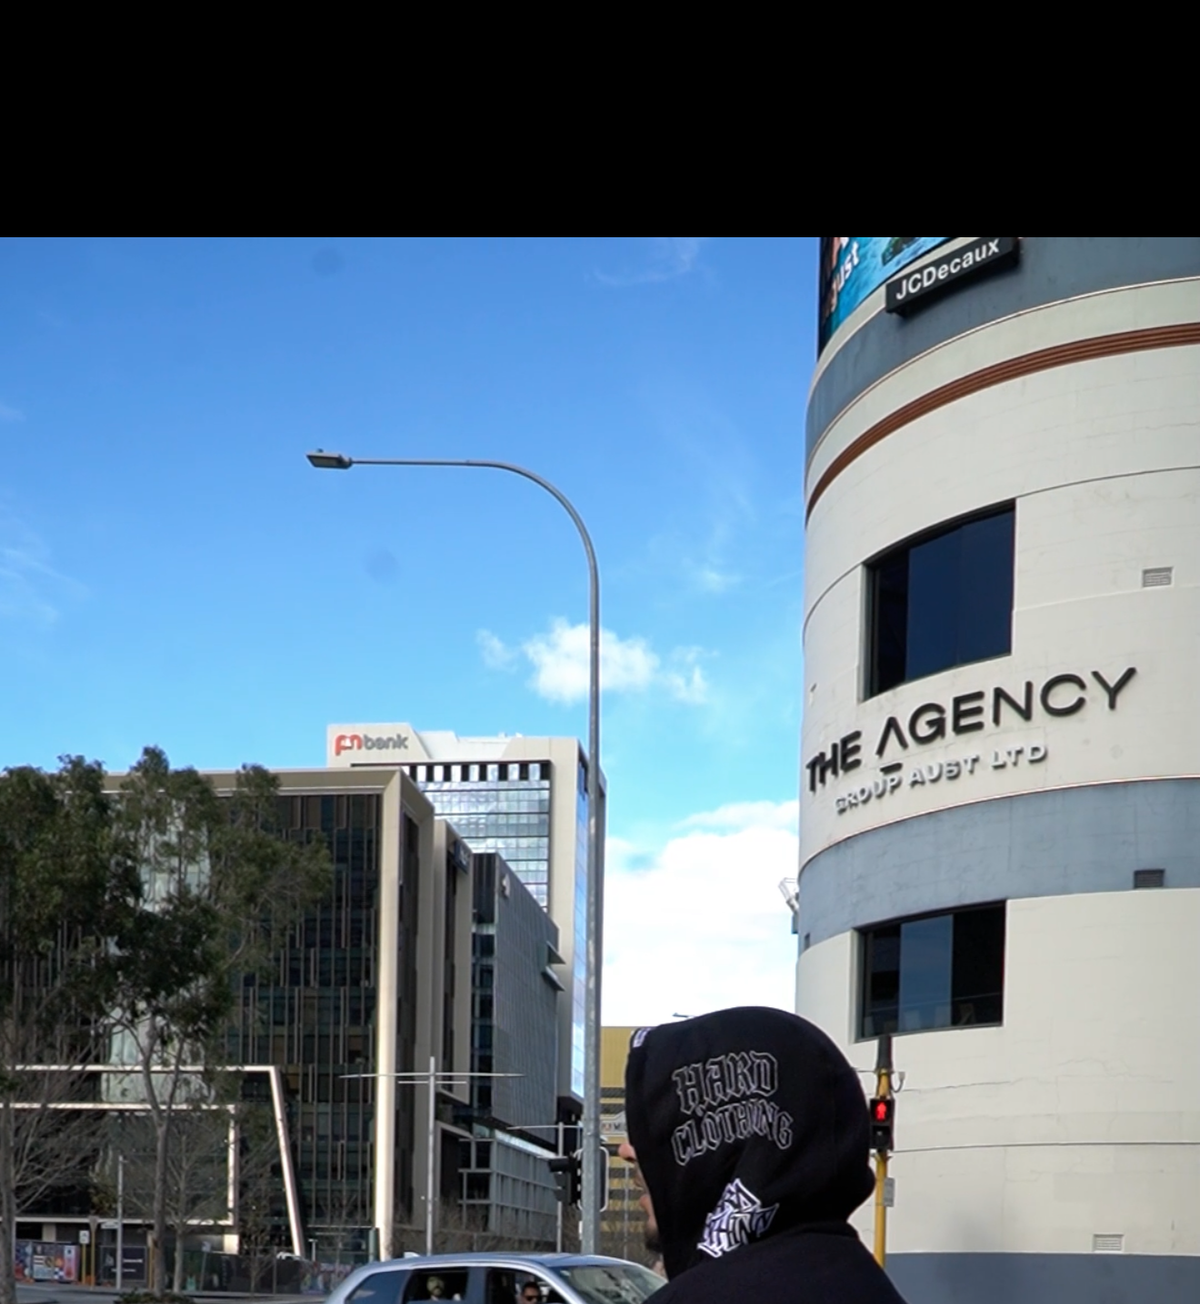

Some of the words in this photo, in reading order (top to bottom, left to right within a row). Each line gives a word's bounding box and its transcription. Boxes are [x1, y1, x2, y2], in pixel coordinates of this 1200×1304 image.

[896, 239, 1000, 300] JCDecaux
[363, 733, 409, 750] bank
[806, 730, 862, 793] THE
[875, 667, 1137, 773] AGENCY
[835, 776, 903, 814] GROUP
[909, 754, 980, 788] AUST
[991, 743, 1048, 770] LTD
[672, 1050, 778, 1117] HARD
[671, 1098, 793, 1166] CLOTHING
